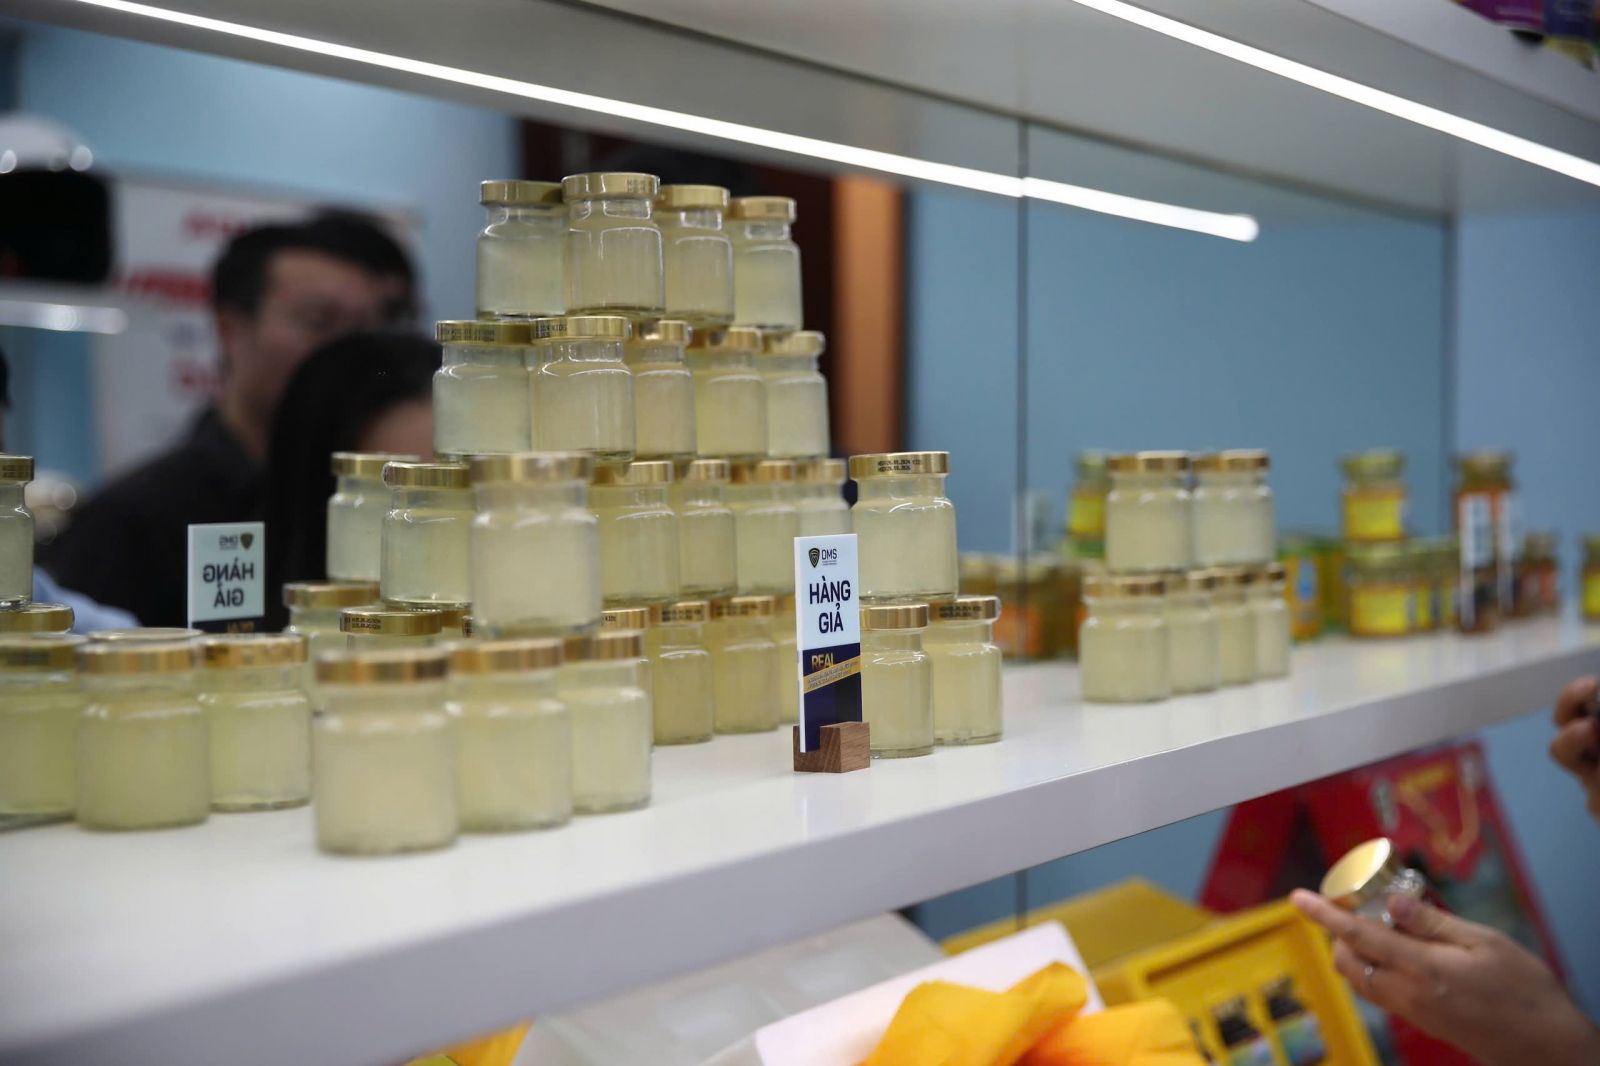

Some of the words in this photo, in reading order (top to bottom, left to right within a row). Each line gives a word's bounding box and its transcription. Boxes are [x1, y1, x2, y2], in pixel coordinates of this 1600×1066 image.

[821, 548, 837, 560] DMS
[809, 575, 851, 605] HÀNG
[818, 602, 844, 634] GIẢ
